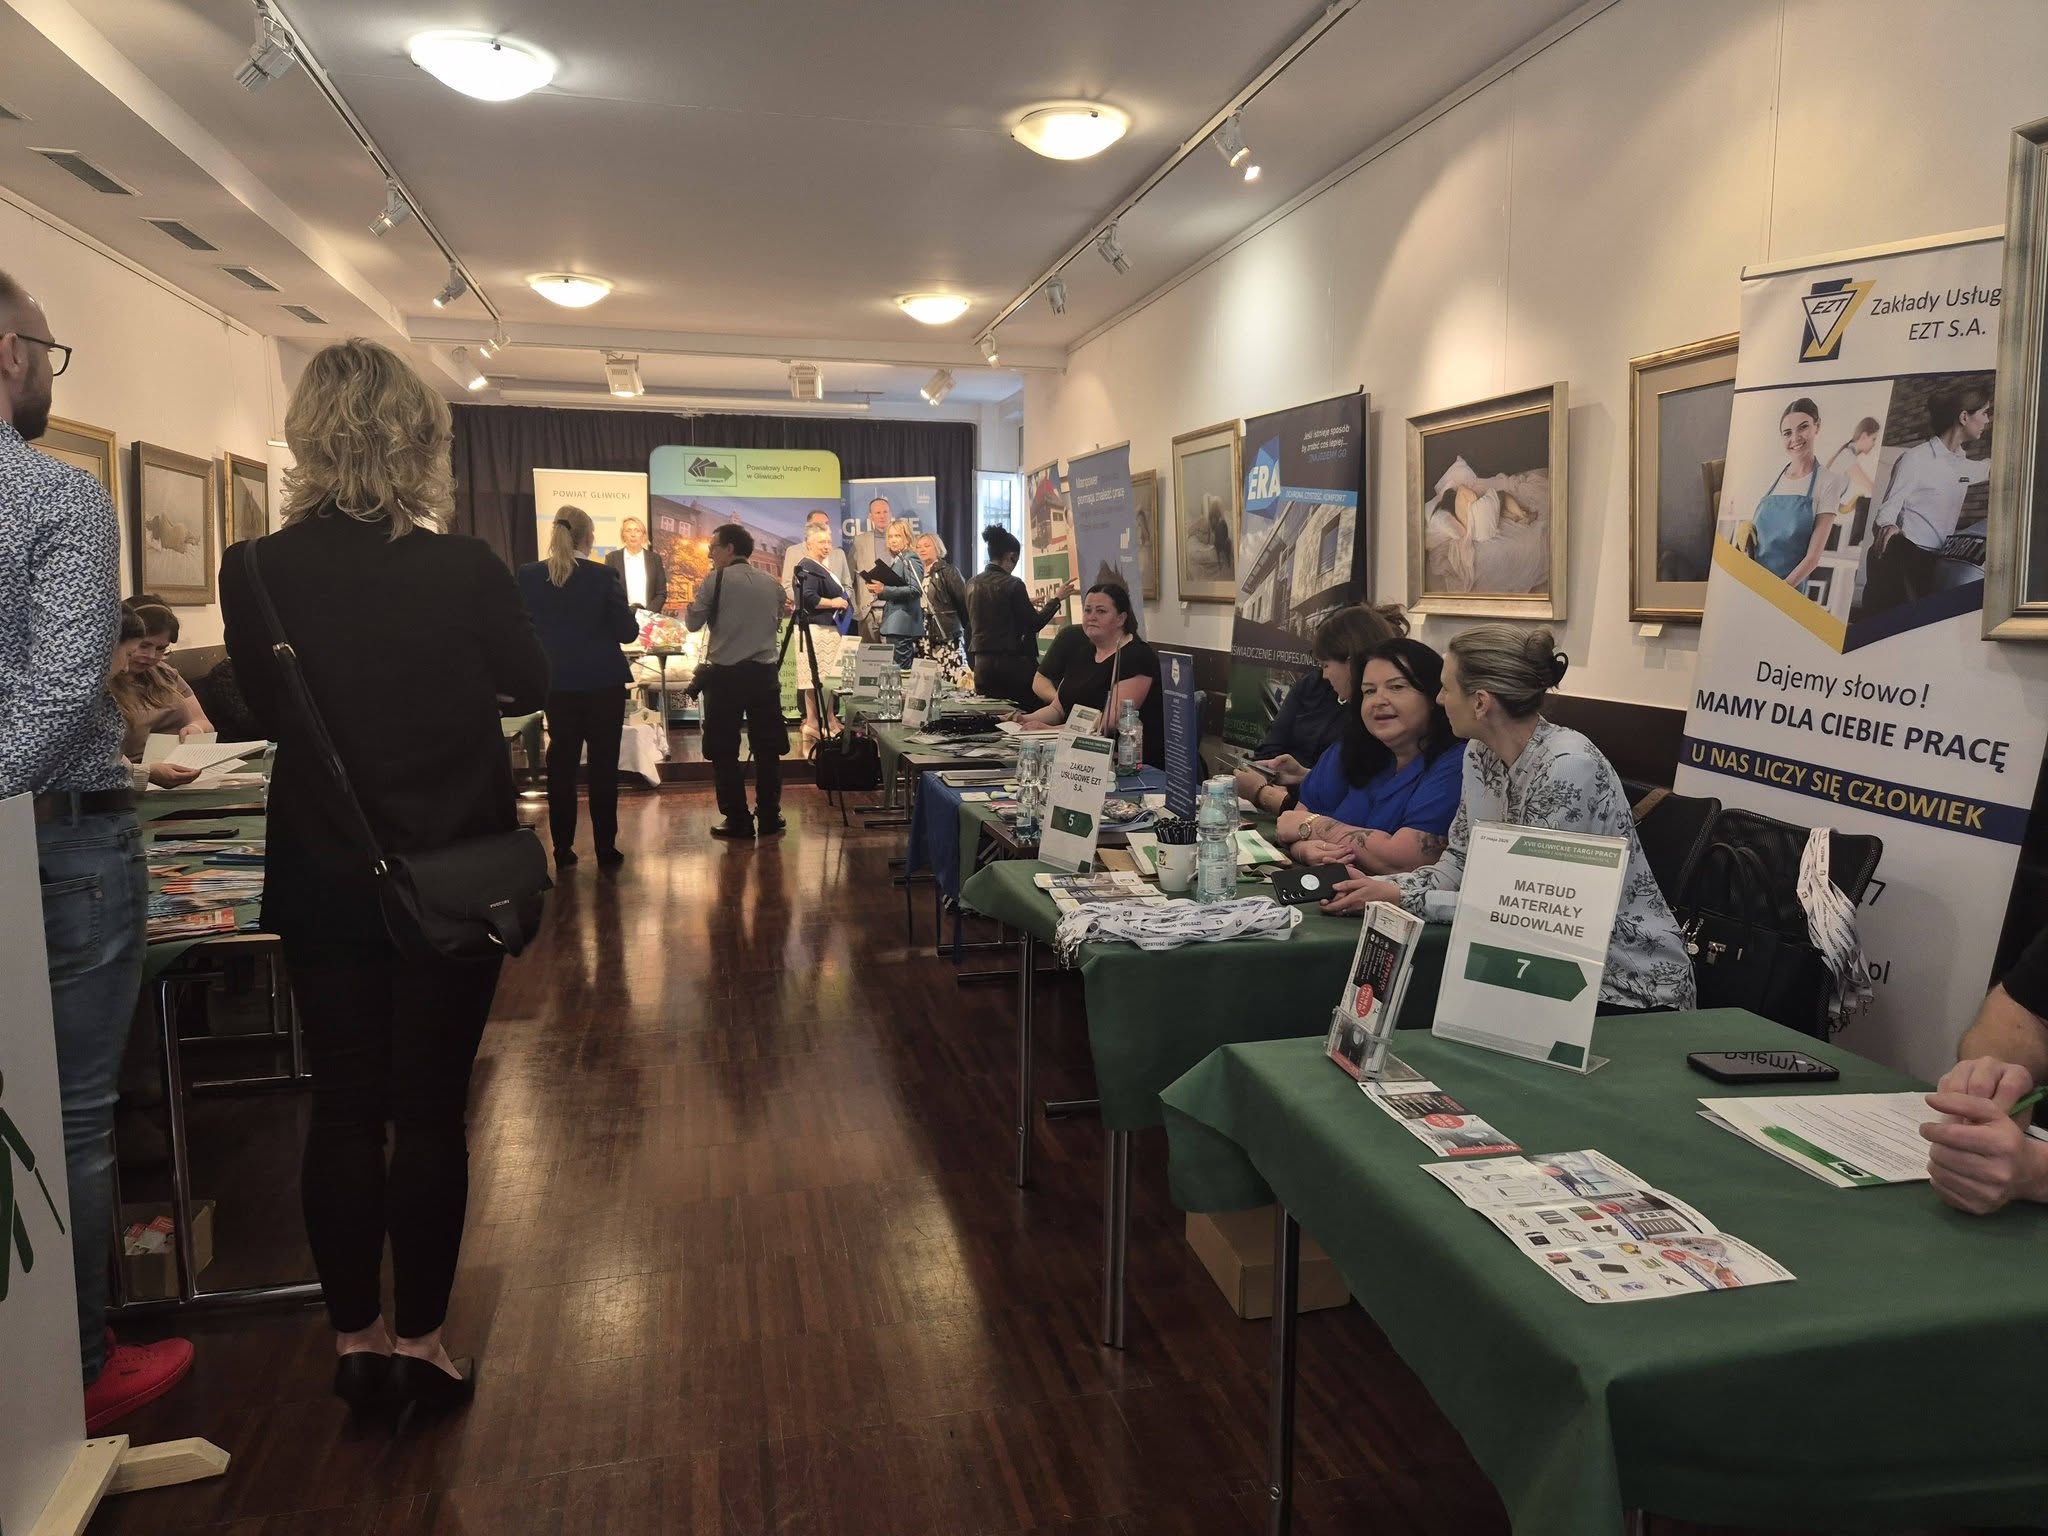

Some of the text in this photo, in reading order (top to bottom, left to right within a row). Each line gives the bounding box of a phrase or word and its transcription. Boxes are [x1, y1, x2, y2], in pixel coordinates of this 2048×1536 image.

[1811, 298, 1849, 316] EZT
[1870, 289, 1940, 316] Zakłady
[1908, 317, 1987, 341] EZT S.A.
[746, 464, 822, 473] Powiatowy Urząd Pracy
[1247, 462, 1281, 500] ERA
[553, 490, 631, 500] POWIAT GLIWICKI
[1757, 661, 1930, 709] Dajemy słowo!
[1695, 689, 2010, 774] MAMY DLA CIEBIE PRACĘ
[1060, 770, 1102, 786] USŁUGOWE EZT
[1069, 762, 1095, 774] ZAKŁADY
[1691, 743, 1986, 830] U NAS LICZY SIĘ CZŁOWIEK
[1068, 814, 1074, 827] 5
[1537, 842, 1571, 853] GLIWICKIE
[1572, 845, 1594, 855] TARGI
[1595, 848, 1619, 859] PRACY
[1514, 879, 1577, 900] MATBUD
[1498, 895, 1583, 919] MATERIAŁY
[1489, 911, 1585, 938] BUDOWLANE
[1516, 958, 1531, 980] 7
